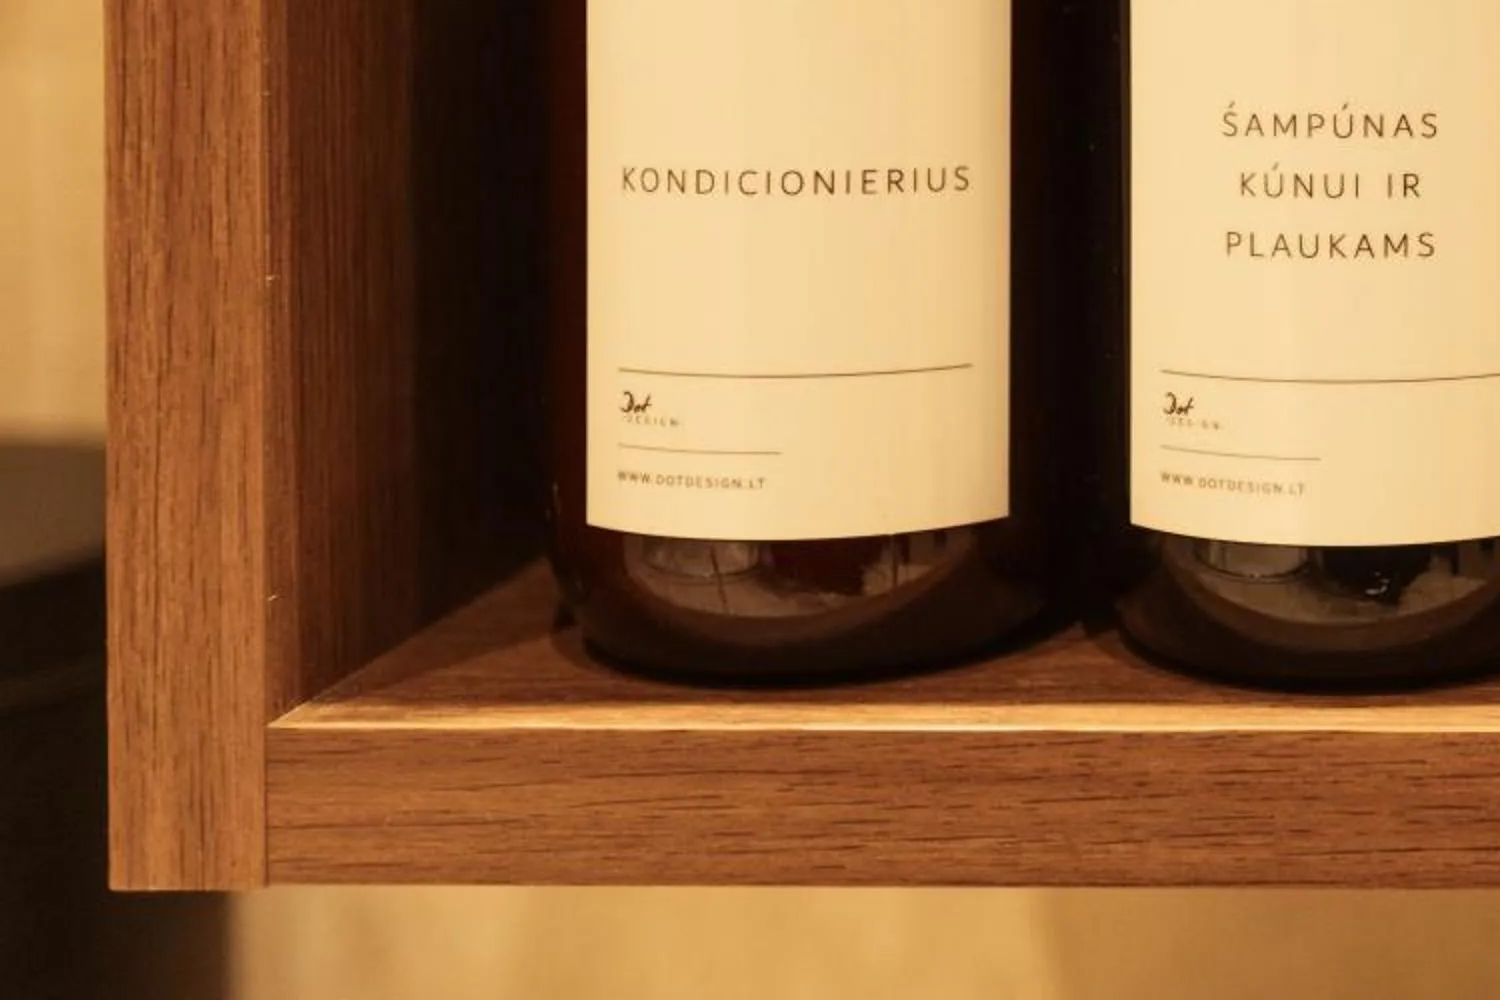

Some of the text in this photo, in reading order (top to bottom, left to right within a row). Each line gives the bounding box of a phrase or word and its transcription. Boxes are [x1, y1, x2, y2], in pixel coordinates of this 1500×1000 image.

[622, 165, 970, 198] KONDICIONIERIUS
[1386, 172, 1421, 199] IR
[1225, 231, 1436, 260] PLAUKAMS
[617, 470, 766, 489] WWW.DOTDESIGN.LT
